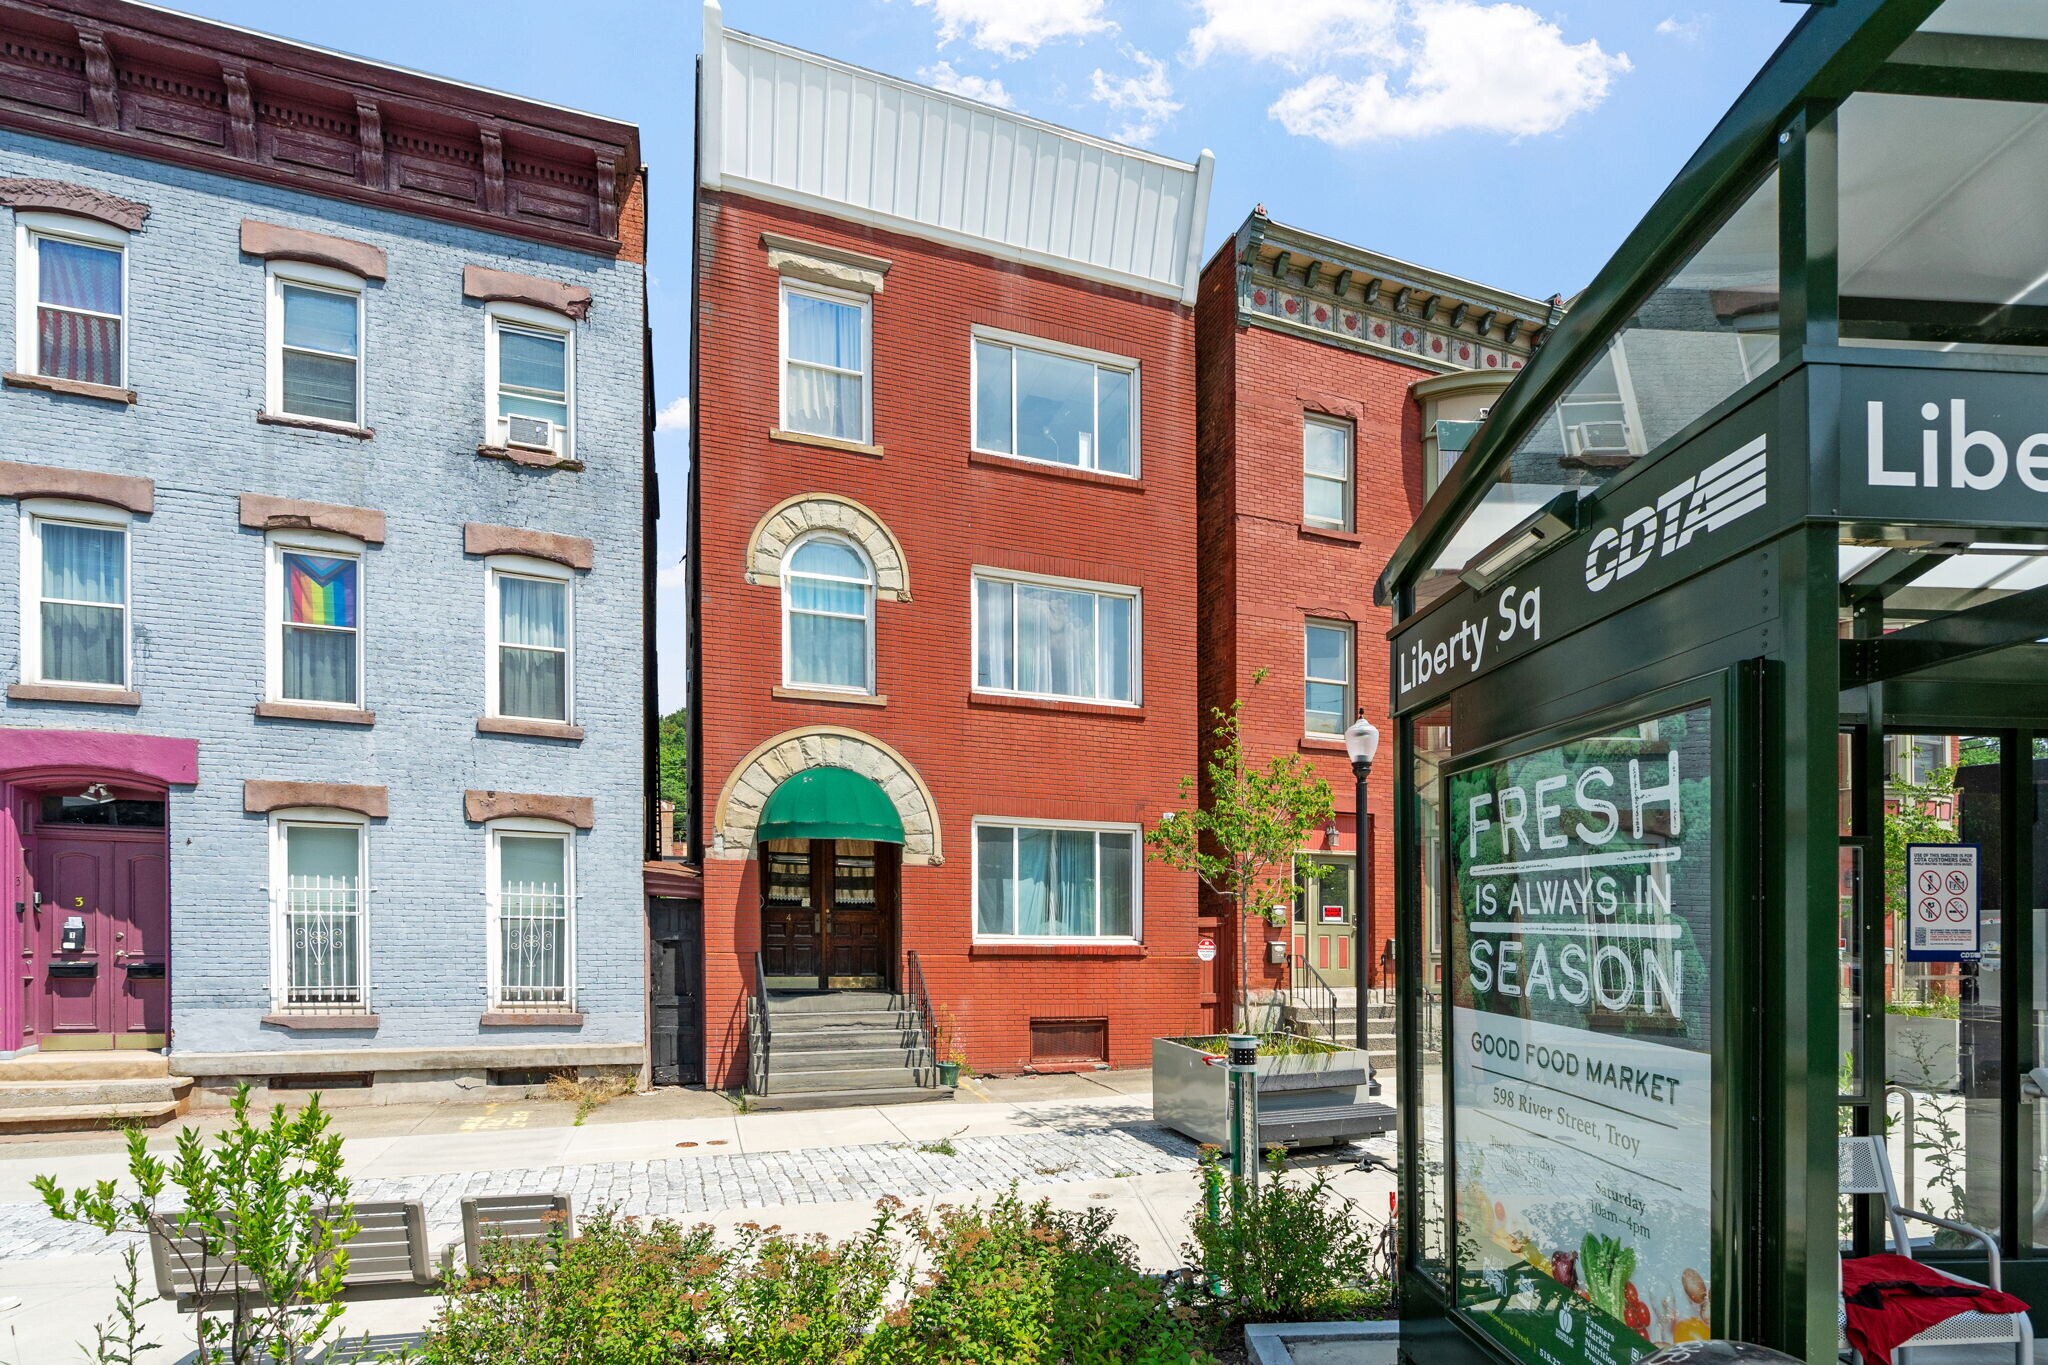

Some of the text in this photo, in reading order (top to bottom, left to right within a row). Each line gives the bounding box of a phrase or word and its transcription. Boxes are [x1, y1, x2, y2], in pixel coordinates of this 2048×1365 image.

[1585, 432, 1767, 592] CDTA
[1400, 585, 1541, 694] Liberty Sq
[1469, 750, 1681, 858] FRESH
[74, 896, 84, 907] 3
[1475, 873, 1672, 915] IS ALWAYS IN
[1469, 939, 1682, 1021] SEASON
[1471, 1031, 1680, 1105] GOOD FOOD MARKET
[1493, 1086, 1641, 1159] 598 River Street, Troy
[1595, 1180, 1646, 1216] Saturday
[1584, 1336, 1617, 1365] Nutrition
[1585, 1315, 1615, 1343] Farmers
[1585, 1326, 1611, 1352] Market
